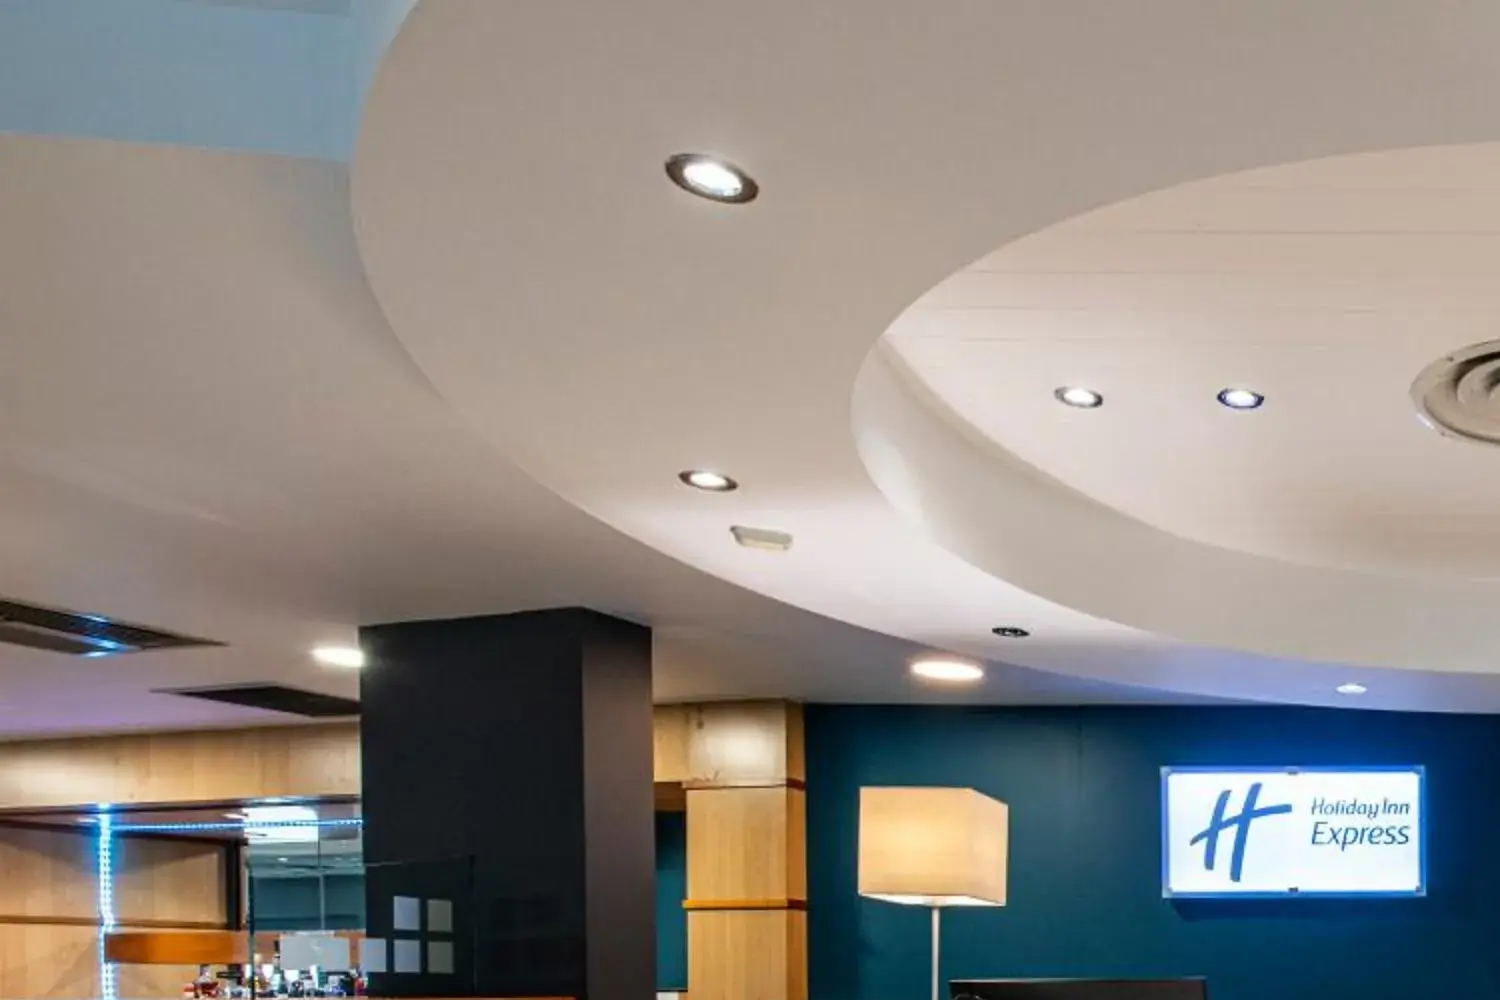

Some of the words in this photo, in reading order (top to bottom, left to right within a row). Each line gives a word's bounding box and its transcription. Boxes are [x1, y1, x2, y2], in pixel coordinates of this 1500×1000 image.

[1310, 796, 1379, 819] Holiday
[1381, 797, 1411, 816] Inn
[1310, 820, 1411, 851] Express
